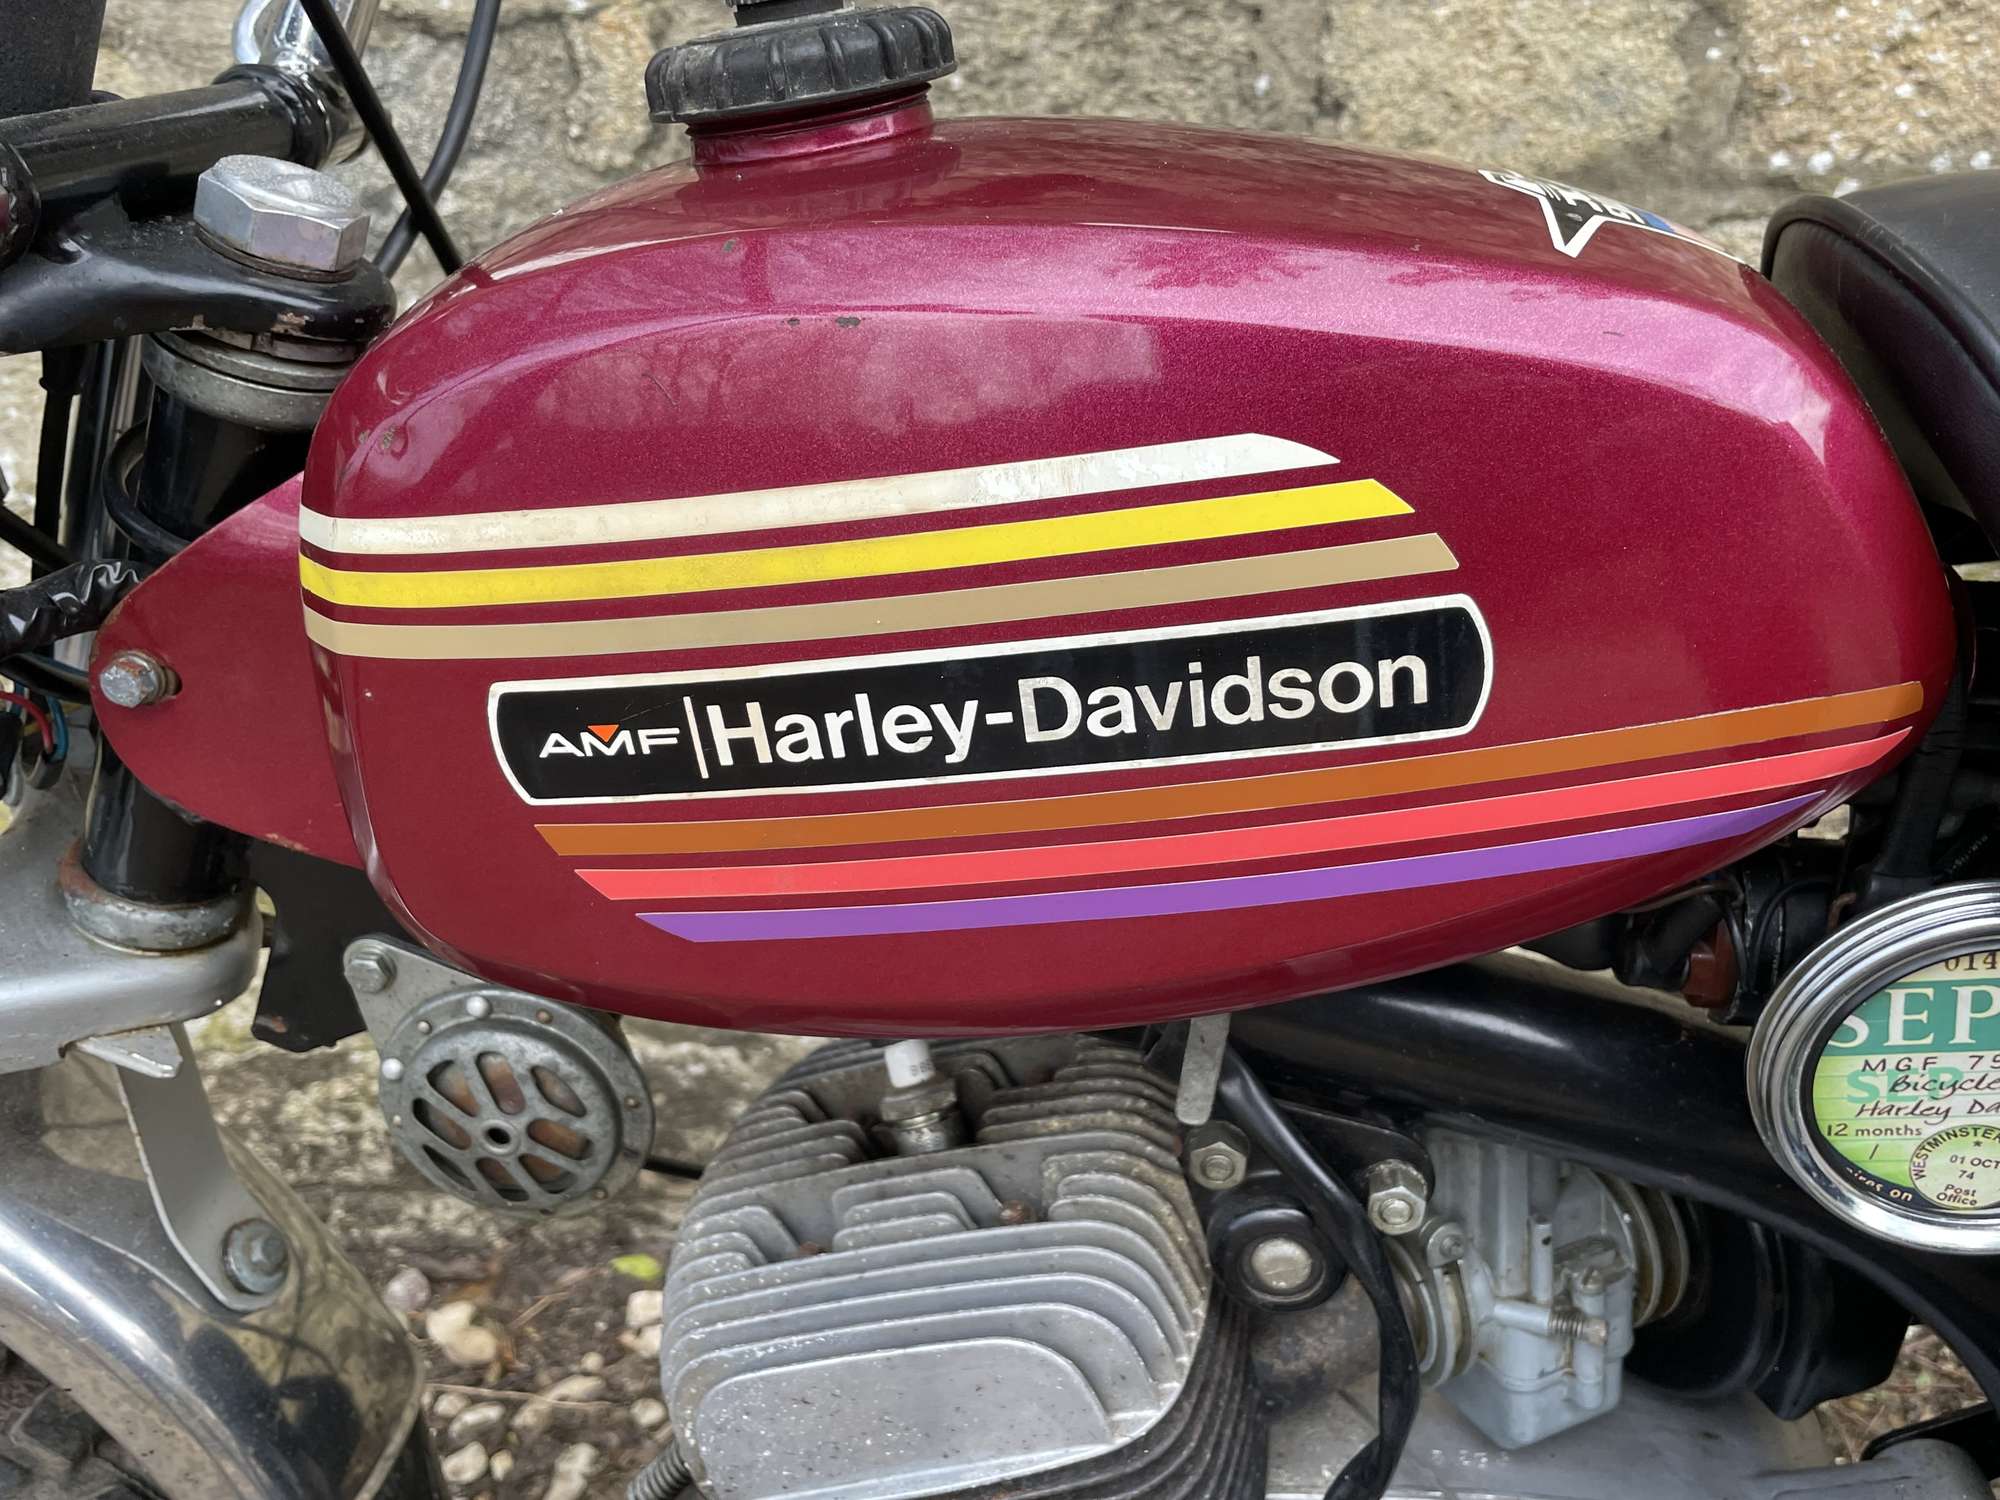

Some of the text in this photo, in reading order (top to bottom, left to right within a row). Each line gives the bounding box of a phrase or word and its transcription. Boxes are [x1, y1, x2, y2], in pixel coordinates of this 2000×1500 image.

[539, 653, 1429, 766] AMF Harley-Davidson
[1862, 1056, 1938, 1073] MGF
[1889, 1073, 2000, 1100] Bicycle
[1855, 1099, 1952, 1125] Harley
[1827, 1123, 1922, 1137] 12 months
[1970, 1157, 2000, 1169] OCT
[1958, 1170, 1975, 1180] 74
[1889, 1188, 1913, 1202] on
[1944, 1184, 1977, 1197] Post
[1936, 1192, 1978, 1206] Office
